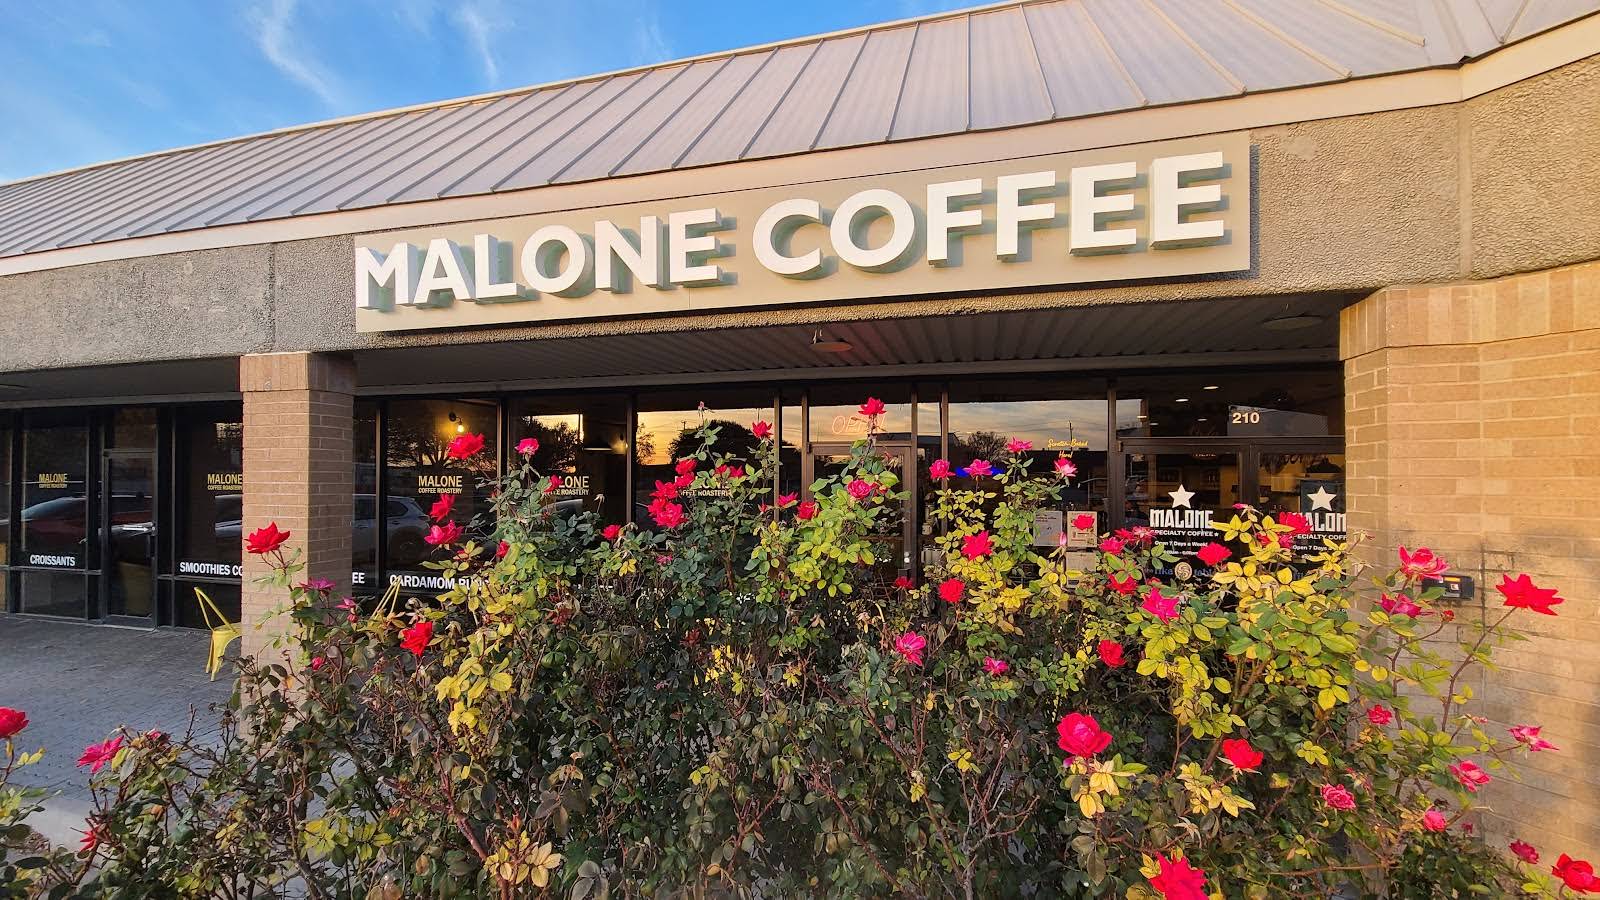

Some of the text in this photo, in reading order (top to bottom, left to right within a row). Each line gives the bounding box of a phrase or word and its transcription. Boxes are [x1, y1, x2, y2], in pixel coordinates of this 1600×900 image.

[354, 152, 1224, 309] MALONE COFFEE
[1232, 413, 1260, 424] 210
[39, 473, 68, 483] MALONE
[207, 474, 243, 485] MALONE
[418, 475, 463, 488] MALONE
[1149, 508, 1214, 529] MALONE
[29, 554, 76, 567] CROISSANTS
[180, 562, 231, 576] SMOOTHIES
[389, 574, 455, 589] CARDAMOM
